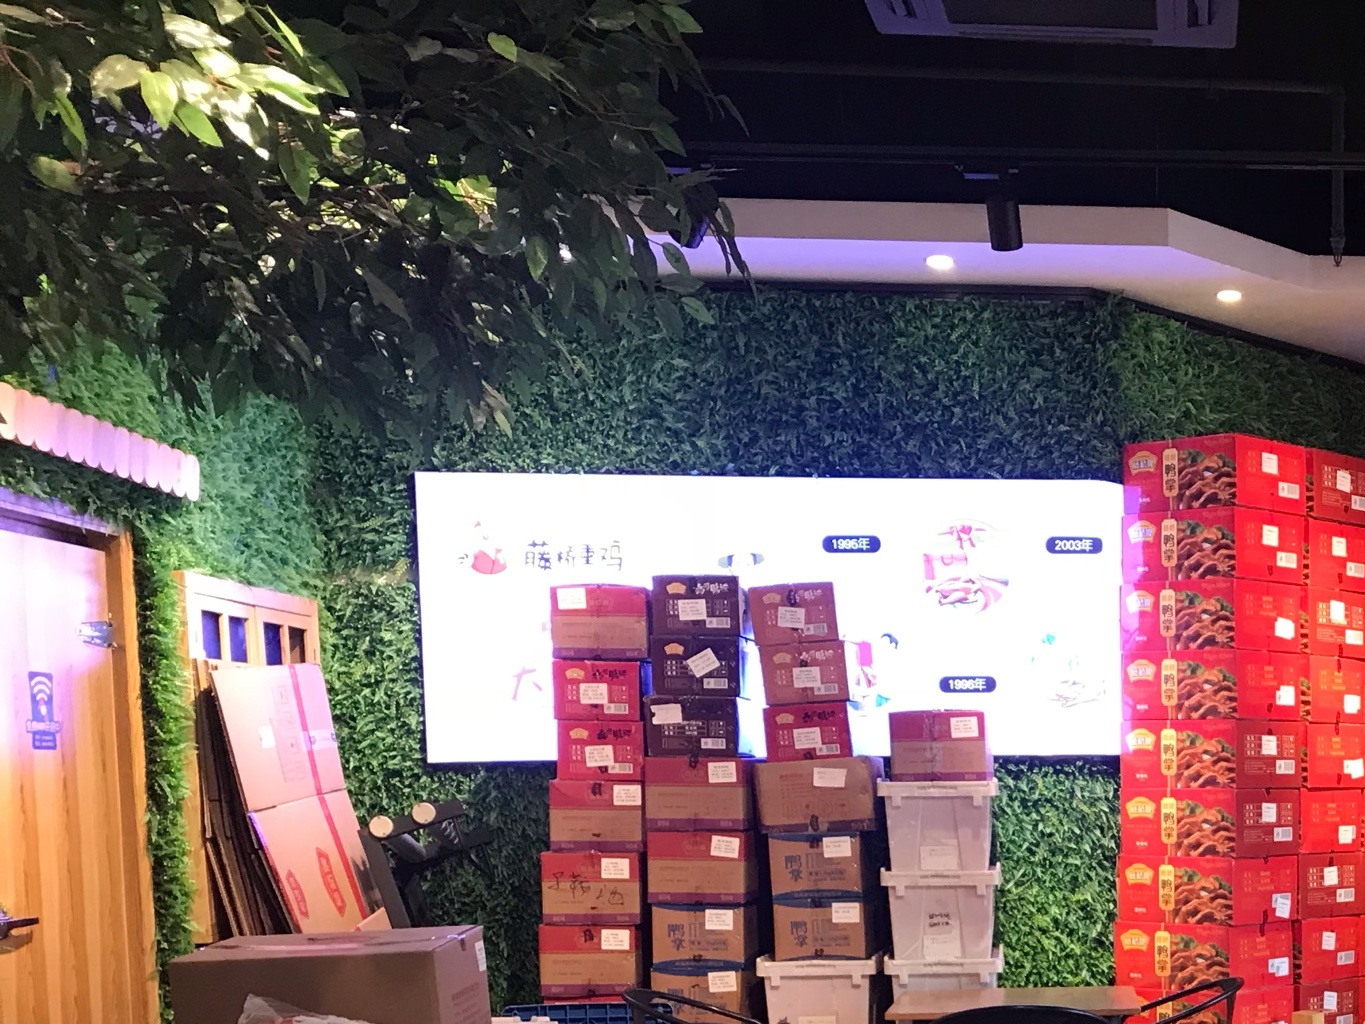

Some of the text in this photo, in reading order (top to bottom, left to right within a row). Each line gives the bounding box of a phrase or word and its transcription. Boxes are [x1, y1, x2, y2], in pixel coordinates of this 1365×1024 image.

[1164, 463, 1176, 492] 鸭掌
[1054, 539, 1093, 553] 2003年
[1163, 534, 1175, 562] 鸭掌
[1161, 603, 1174, 632] 鸭掌
[1160, 878, 1172, 906] 鸭掌
[1156, 945, 1168, 973] 鸭掌
